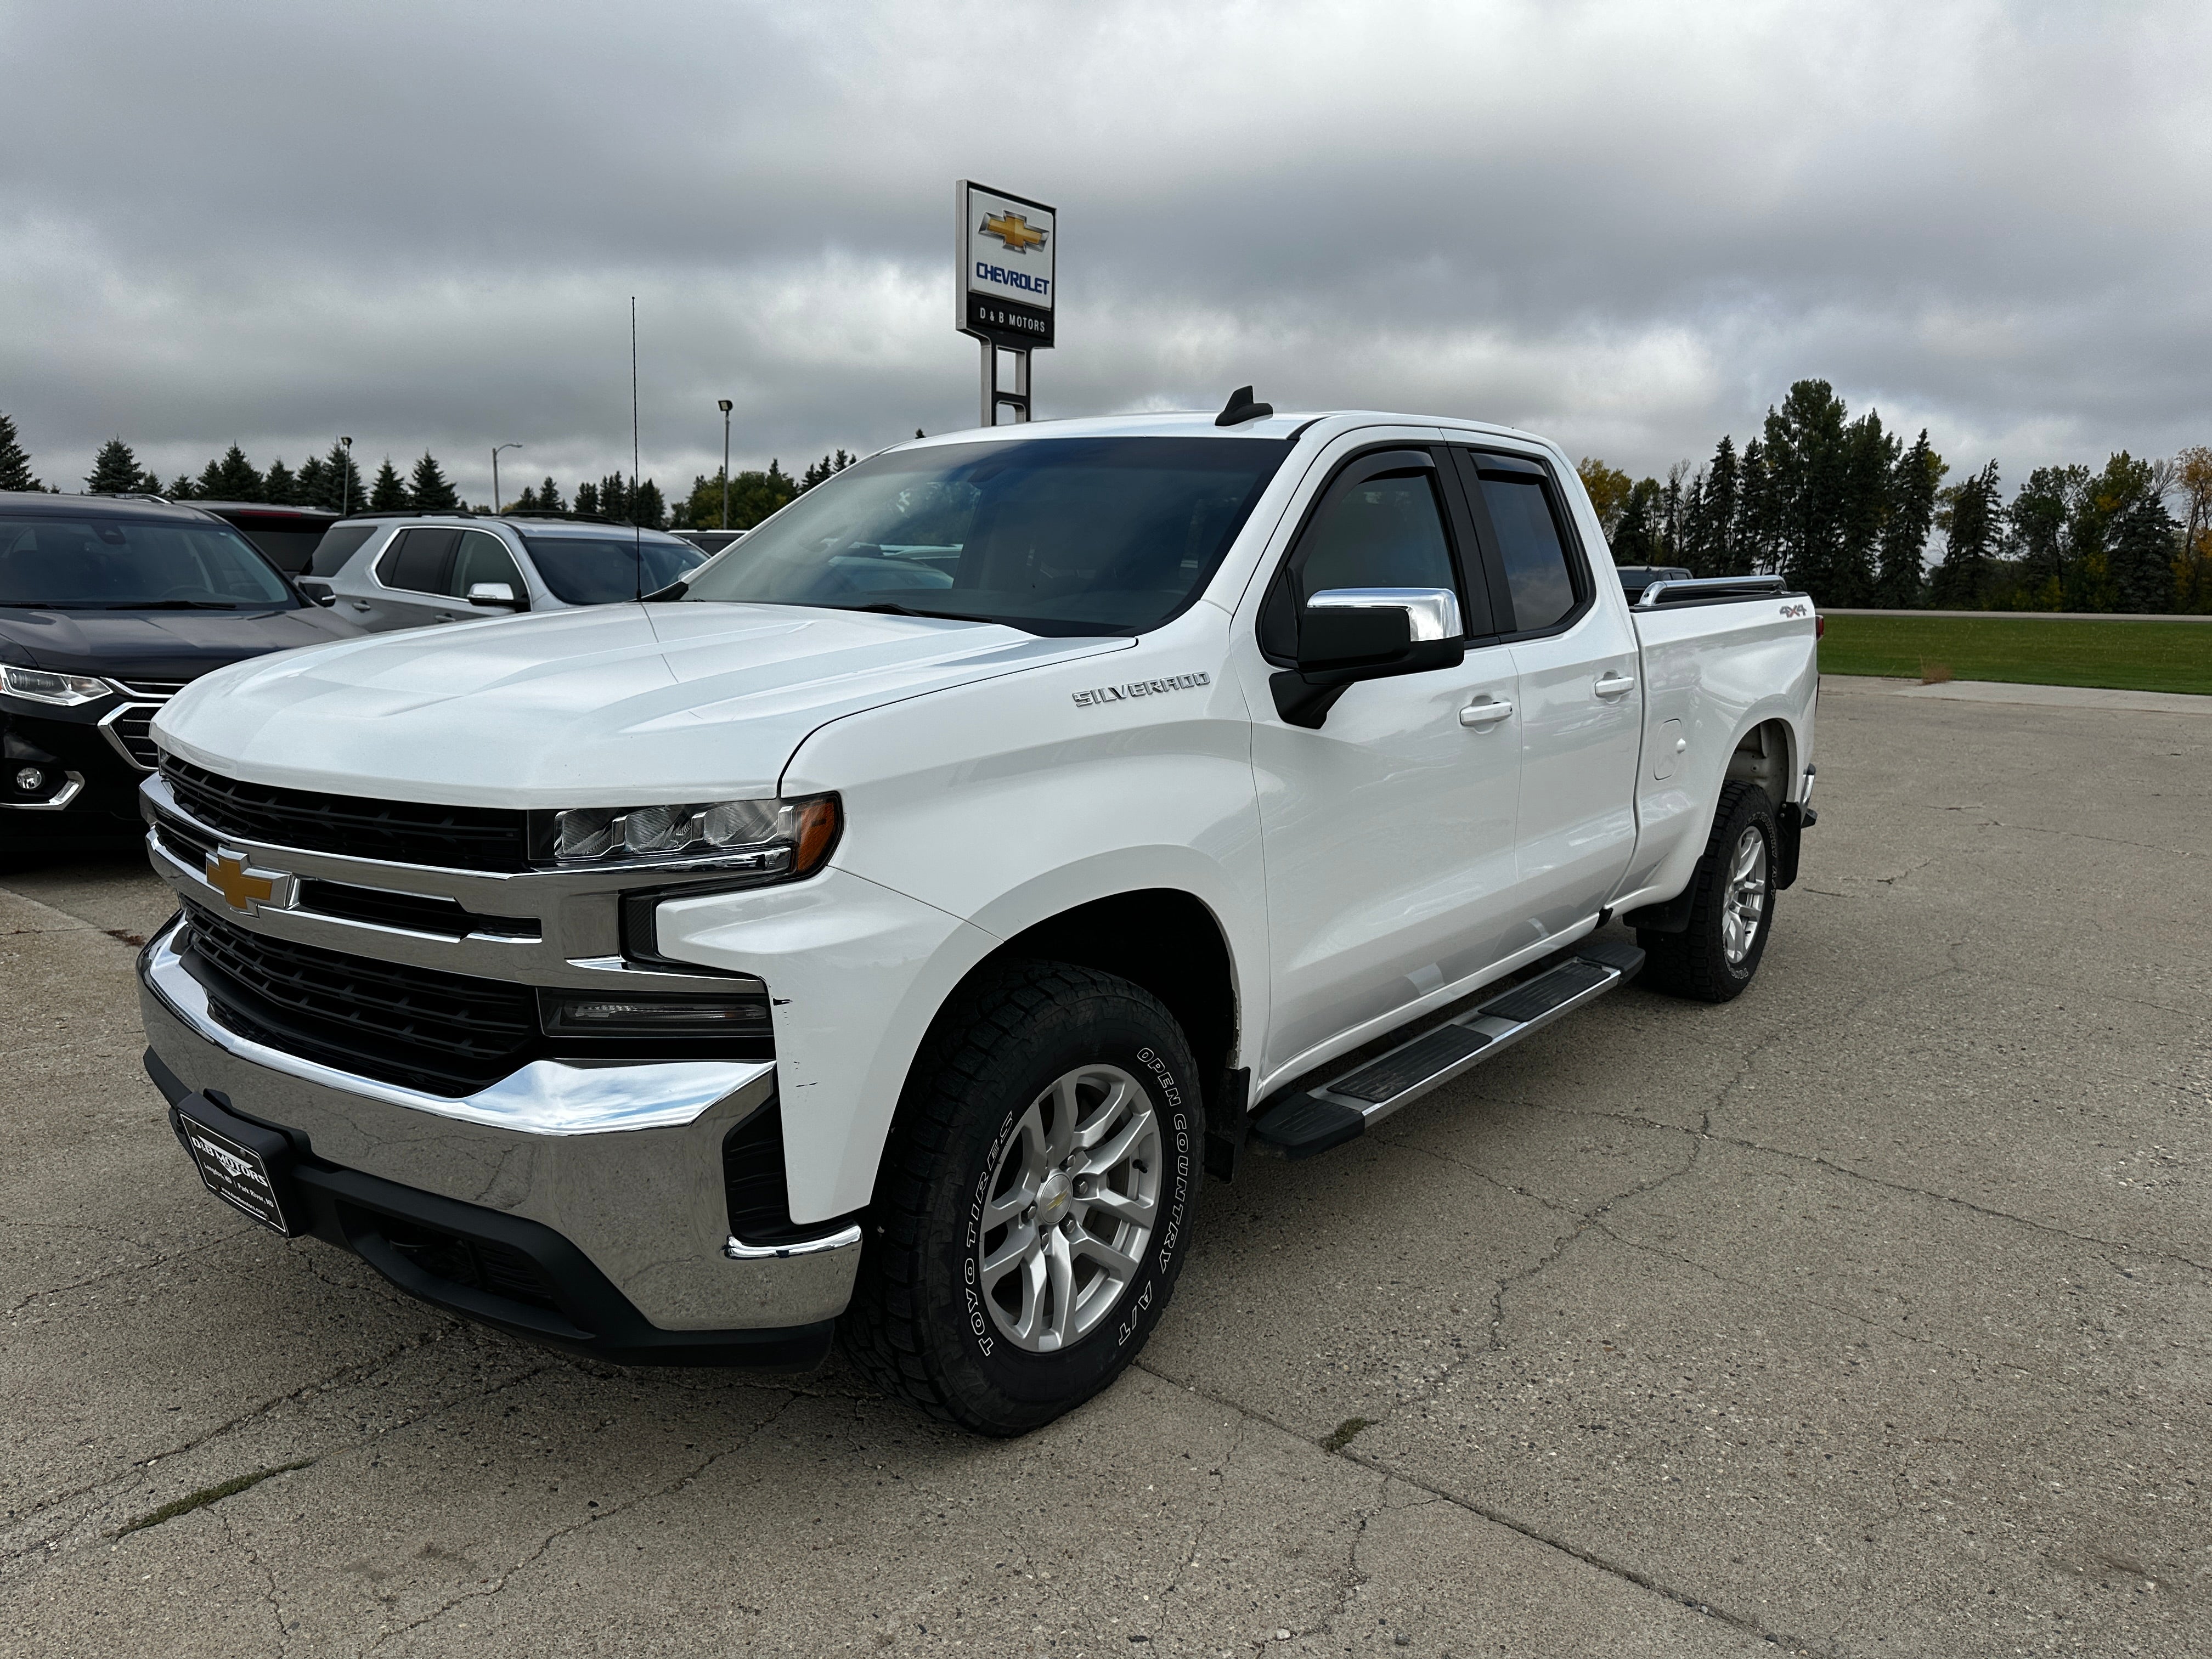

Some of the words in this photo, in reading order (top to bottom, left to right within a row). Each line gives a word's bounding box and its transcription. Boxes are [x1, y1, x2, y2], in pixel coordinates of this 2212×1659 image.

[976, 262, 1049, 295] CHEVROLET
[980, 307, 986, 319] D
[990, 311, 995, 321] &
[998, 311, 1005, 323] B
[1009, 313, 1045, 332] MOTORS
[1072, 671, 1211, 707] SILVERADO
[1137, 1047, 1181, 1107] OPEN
[191, 1136, 215, 1157] D&B
[215, 1149, 268, 1187] MOTORS
[967, 1110, 1012, 1248] TIRES
[1159, 1113, 1188, 1274] COUNTRY
[964, 1258, 994, 1356] TOYO
[1118, 1280, 1152, 1346] A/T
